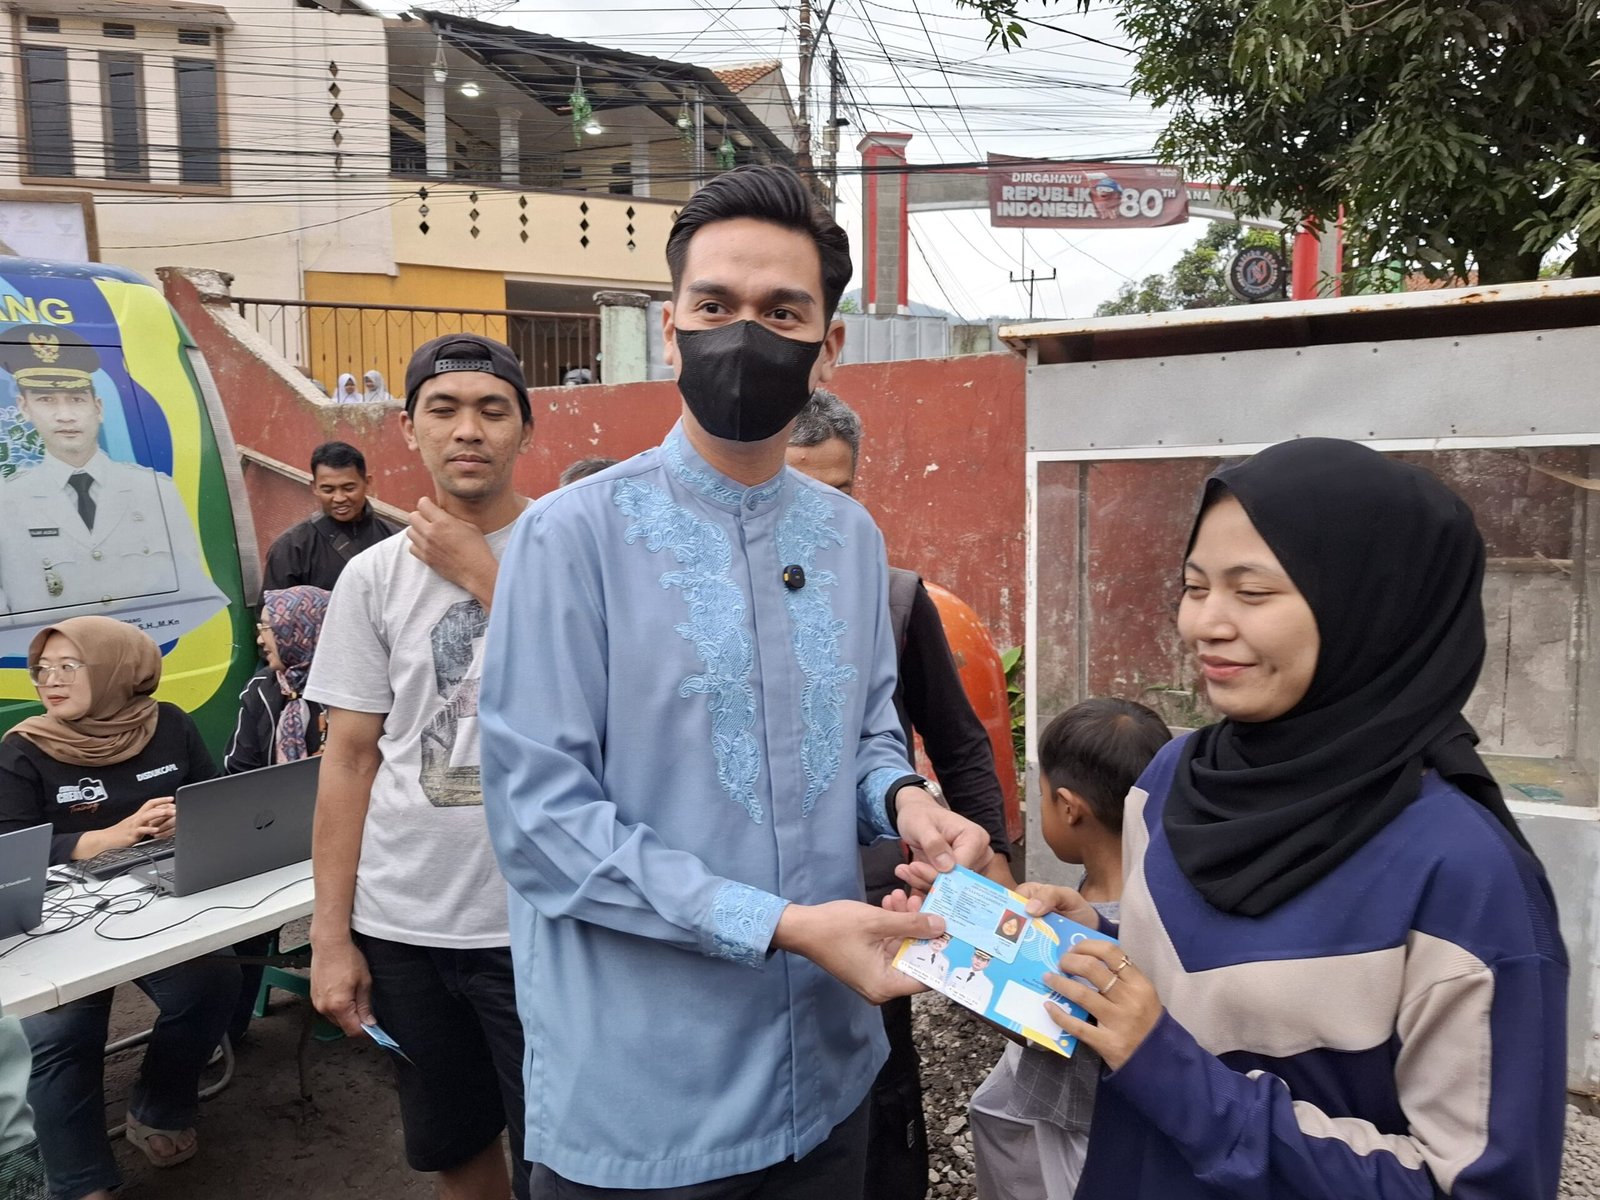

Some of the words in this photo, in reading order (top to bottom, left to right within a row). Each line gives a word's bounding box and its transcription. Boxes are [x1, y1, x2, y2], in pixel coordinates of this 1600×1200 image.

[1011, 172, 1082, 184] DIRGAHAYU
[1002, 185, 1092, 202] REPUBLIK
[997, 201, 1098, 218] INDONESIA
